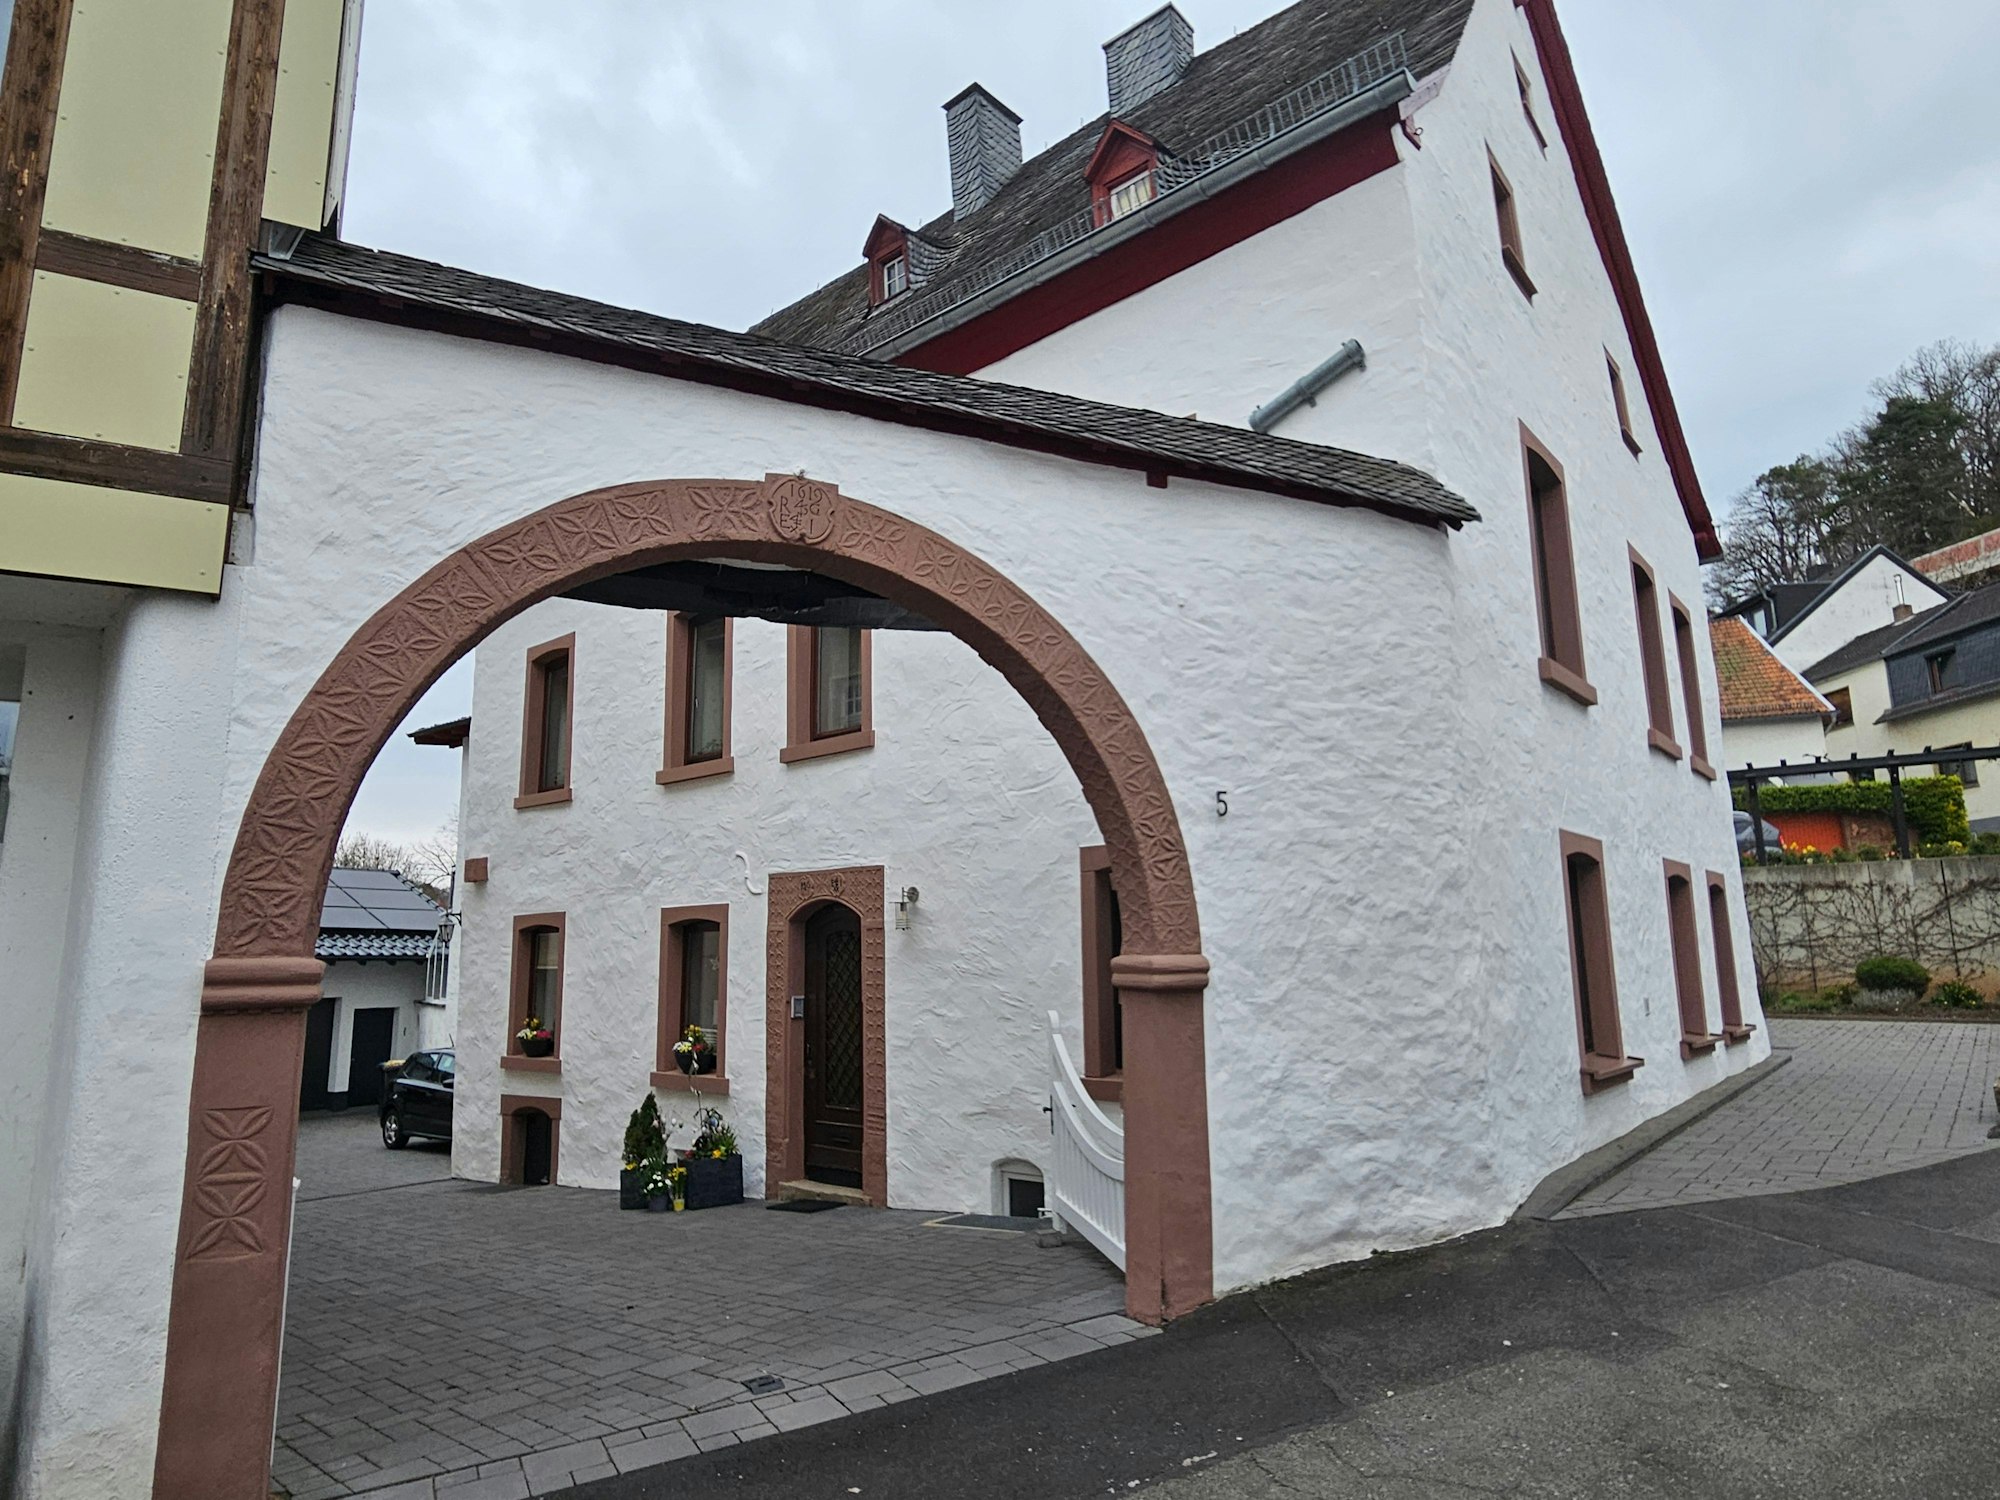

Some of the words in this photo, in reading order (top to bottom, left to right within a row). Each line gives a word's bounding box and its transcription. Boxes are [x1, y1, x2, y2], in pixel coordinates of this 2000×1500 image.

[790, 482, 823, 504] 1619
[780, 495, 791, 514] R
[1216, 790, 1228, 818] 5
